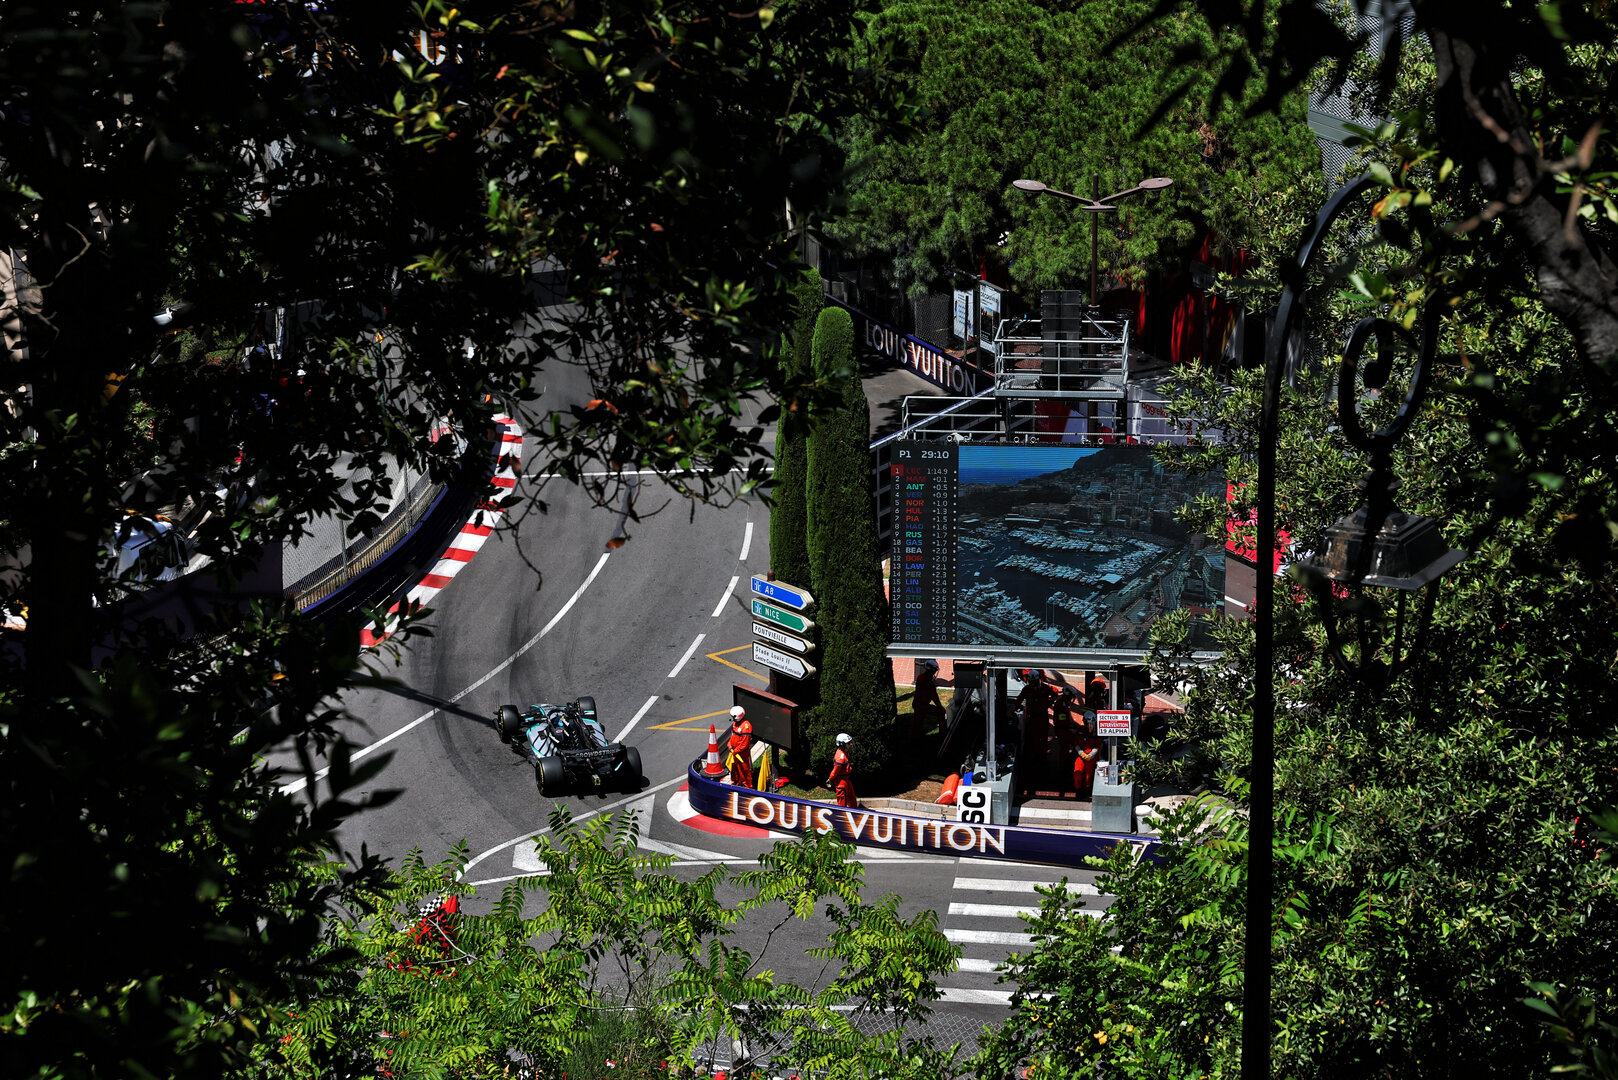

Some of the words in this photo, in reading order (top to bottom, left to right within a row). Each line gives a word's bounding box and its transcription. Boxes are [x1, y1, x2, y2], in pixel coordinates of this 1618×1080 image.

[866, 320, 908, 364] LOUIS
[909, 342, 976, 397] VUITTON
[900, 450, 911, 458] P1
[921, 450, 949, 458] 29:10
[765, 585, 774, 595] A8
[765, 608, 780, 620] NICE
[755, 626, 787, 643] FONTVIEILLE
[755, 646, 769, 656] Stade
[771, 652, 784, 662] Louis
[962, 790, 986, 824] SC
[732, 792, 834, 835] LOUIS
[846, 811, 1006, 856] VUITTON
